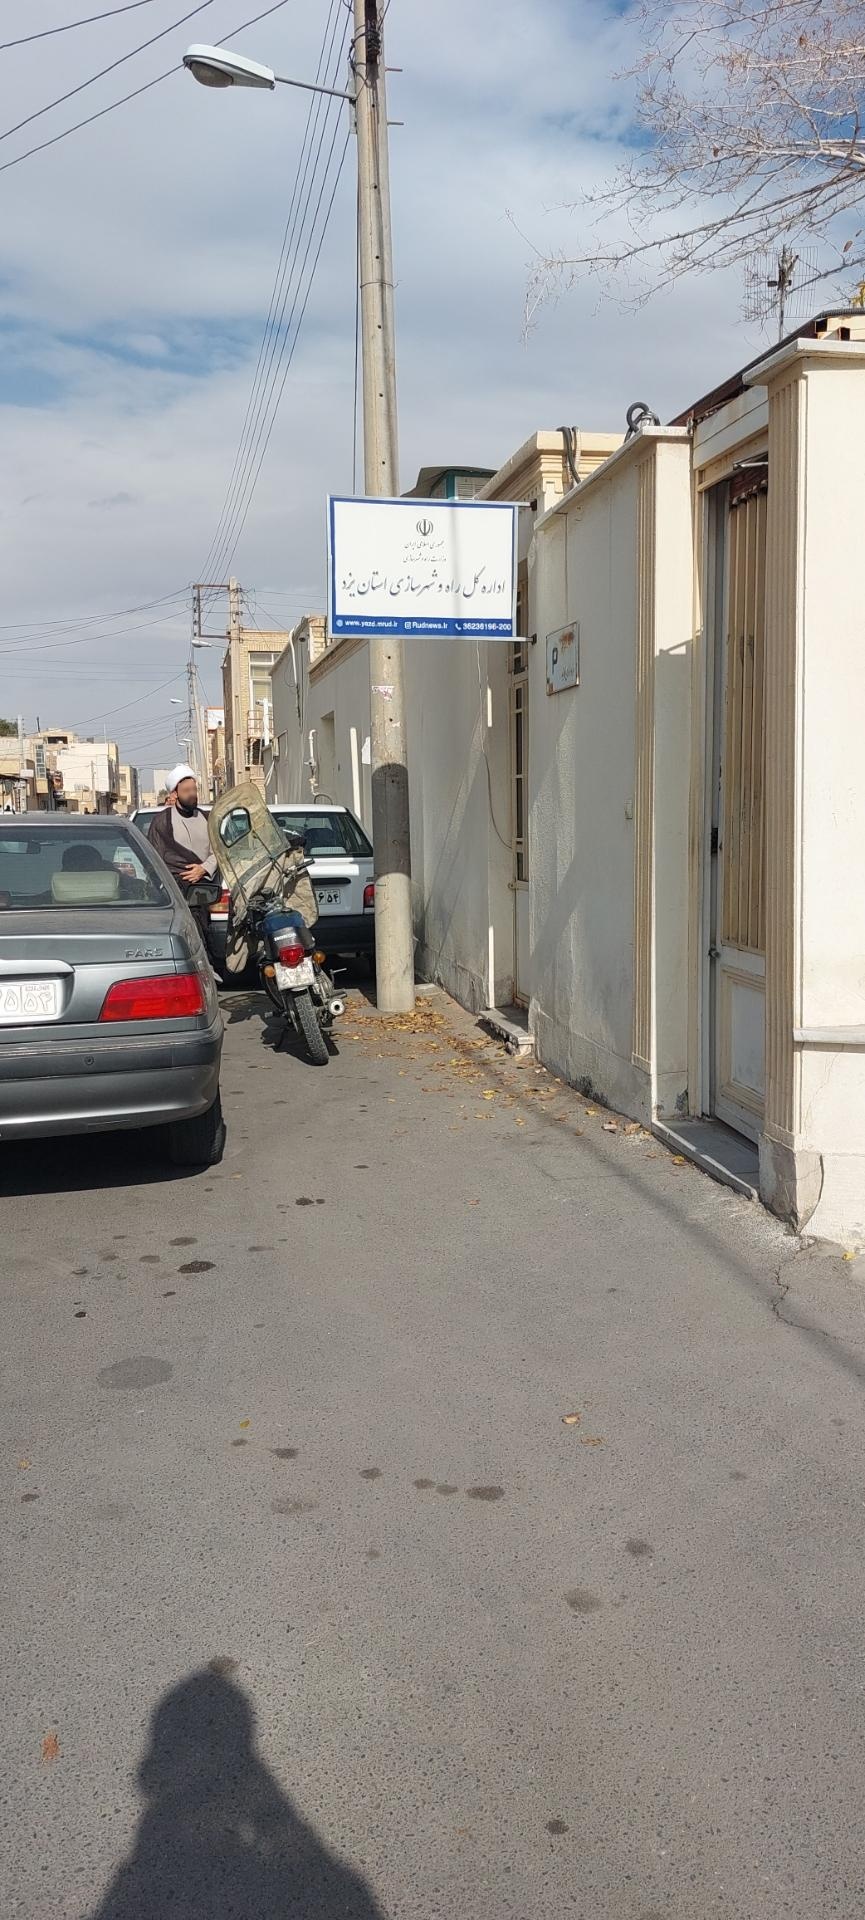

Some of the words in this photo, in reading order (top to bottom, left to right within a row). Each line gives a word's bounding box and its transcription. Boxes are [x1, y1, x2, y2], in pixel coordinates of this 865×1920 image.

[342, 572, 355, 597] یزد
[357, 570, 388, 597] استان
[437, 583, 444, 593] و
[444, 578, 462, 594] راه
[462, 565, 487, 600] کل
[481, 578, 506, 594] اداره
[552, 647, 558, 675] P
[125, 947, 163, 957] PARS
